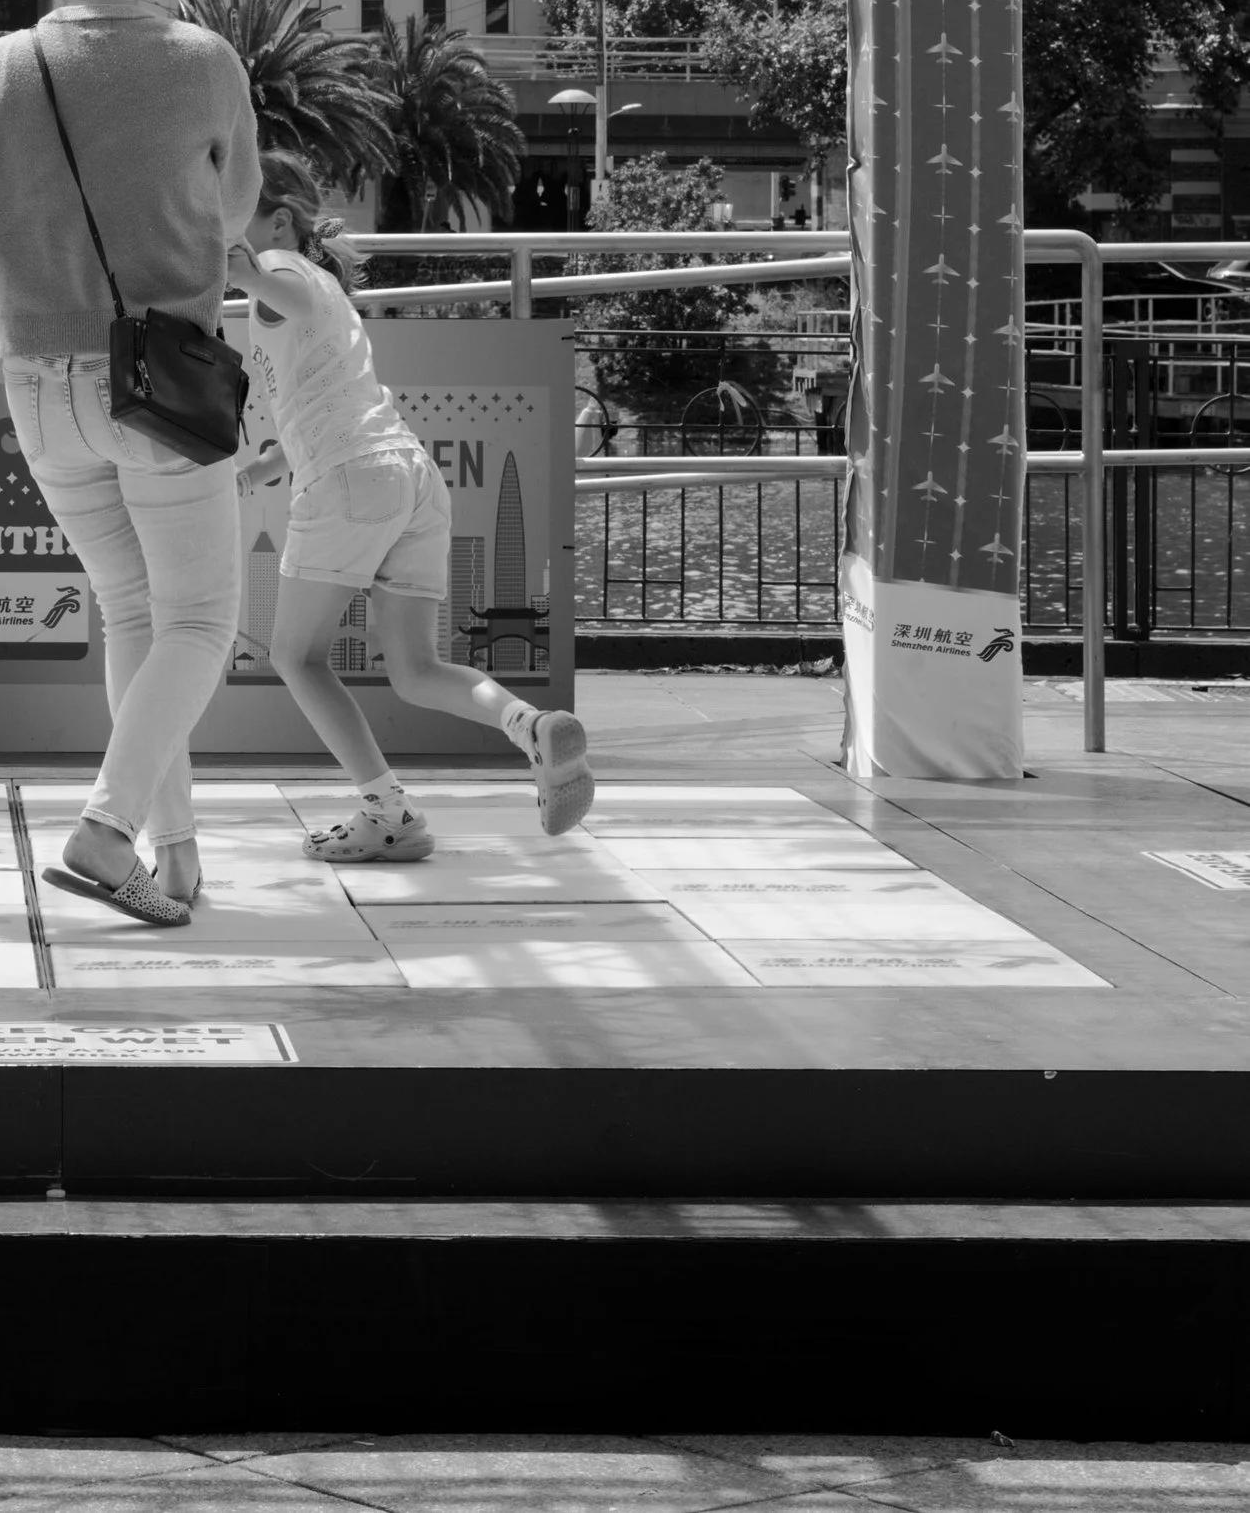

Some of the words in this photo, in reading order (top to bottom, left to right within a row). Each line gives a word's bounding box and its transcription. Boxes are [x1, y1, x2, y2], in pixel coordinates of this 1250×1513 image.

[894, 623, 973, 647] 深圳航空
[891, 639, 933, 652] Shenzhen
[936, 645, 971, 656] Airlines
[70, 1027, 245, 1035] CARE
[100, 1036, 243, 1044] WET
